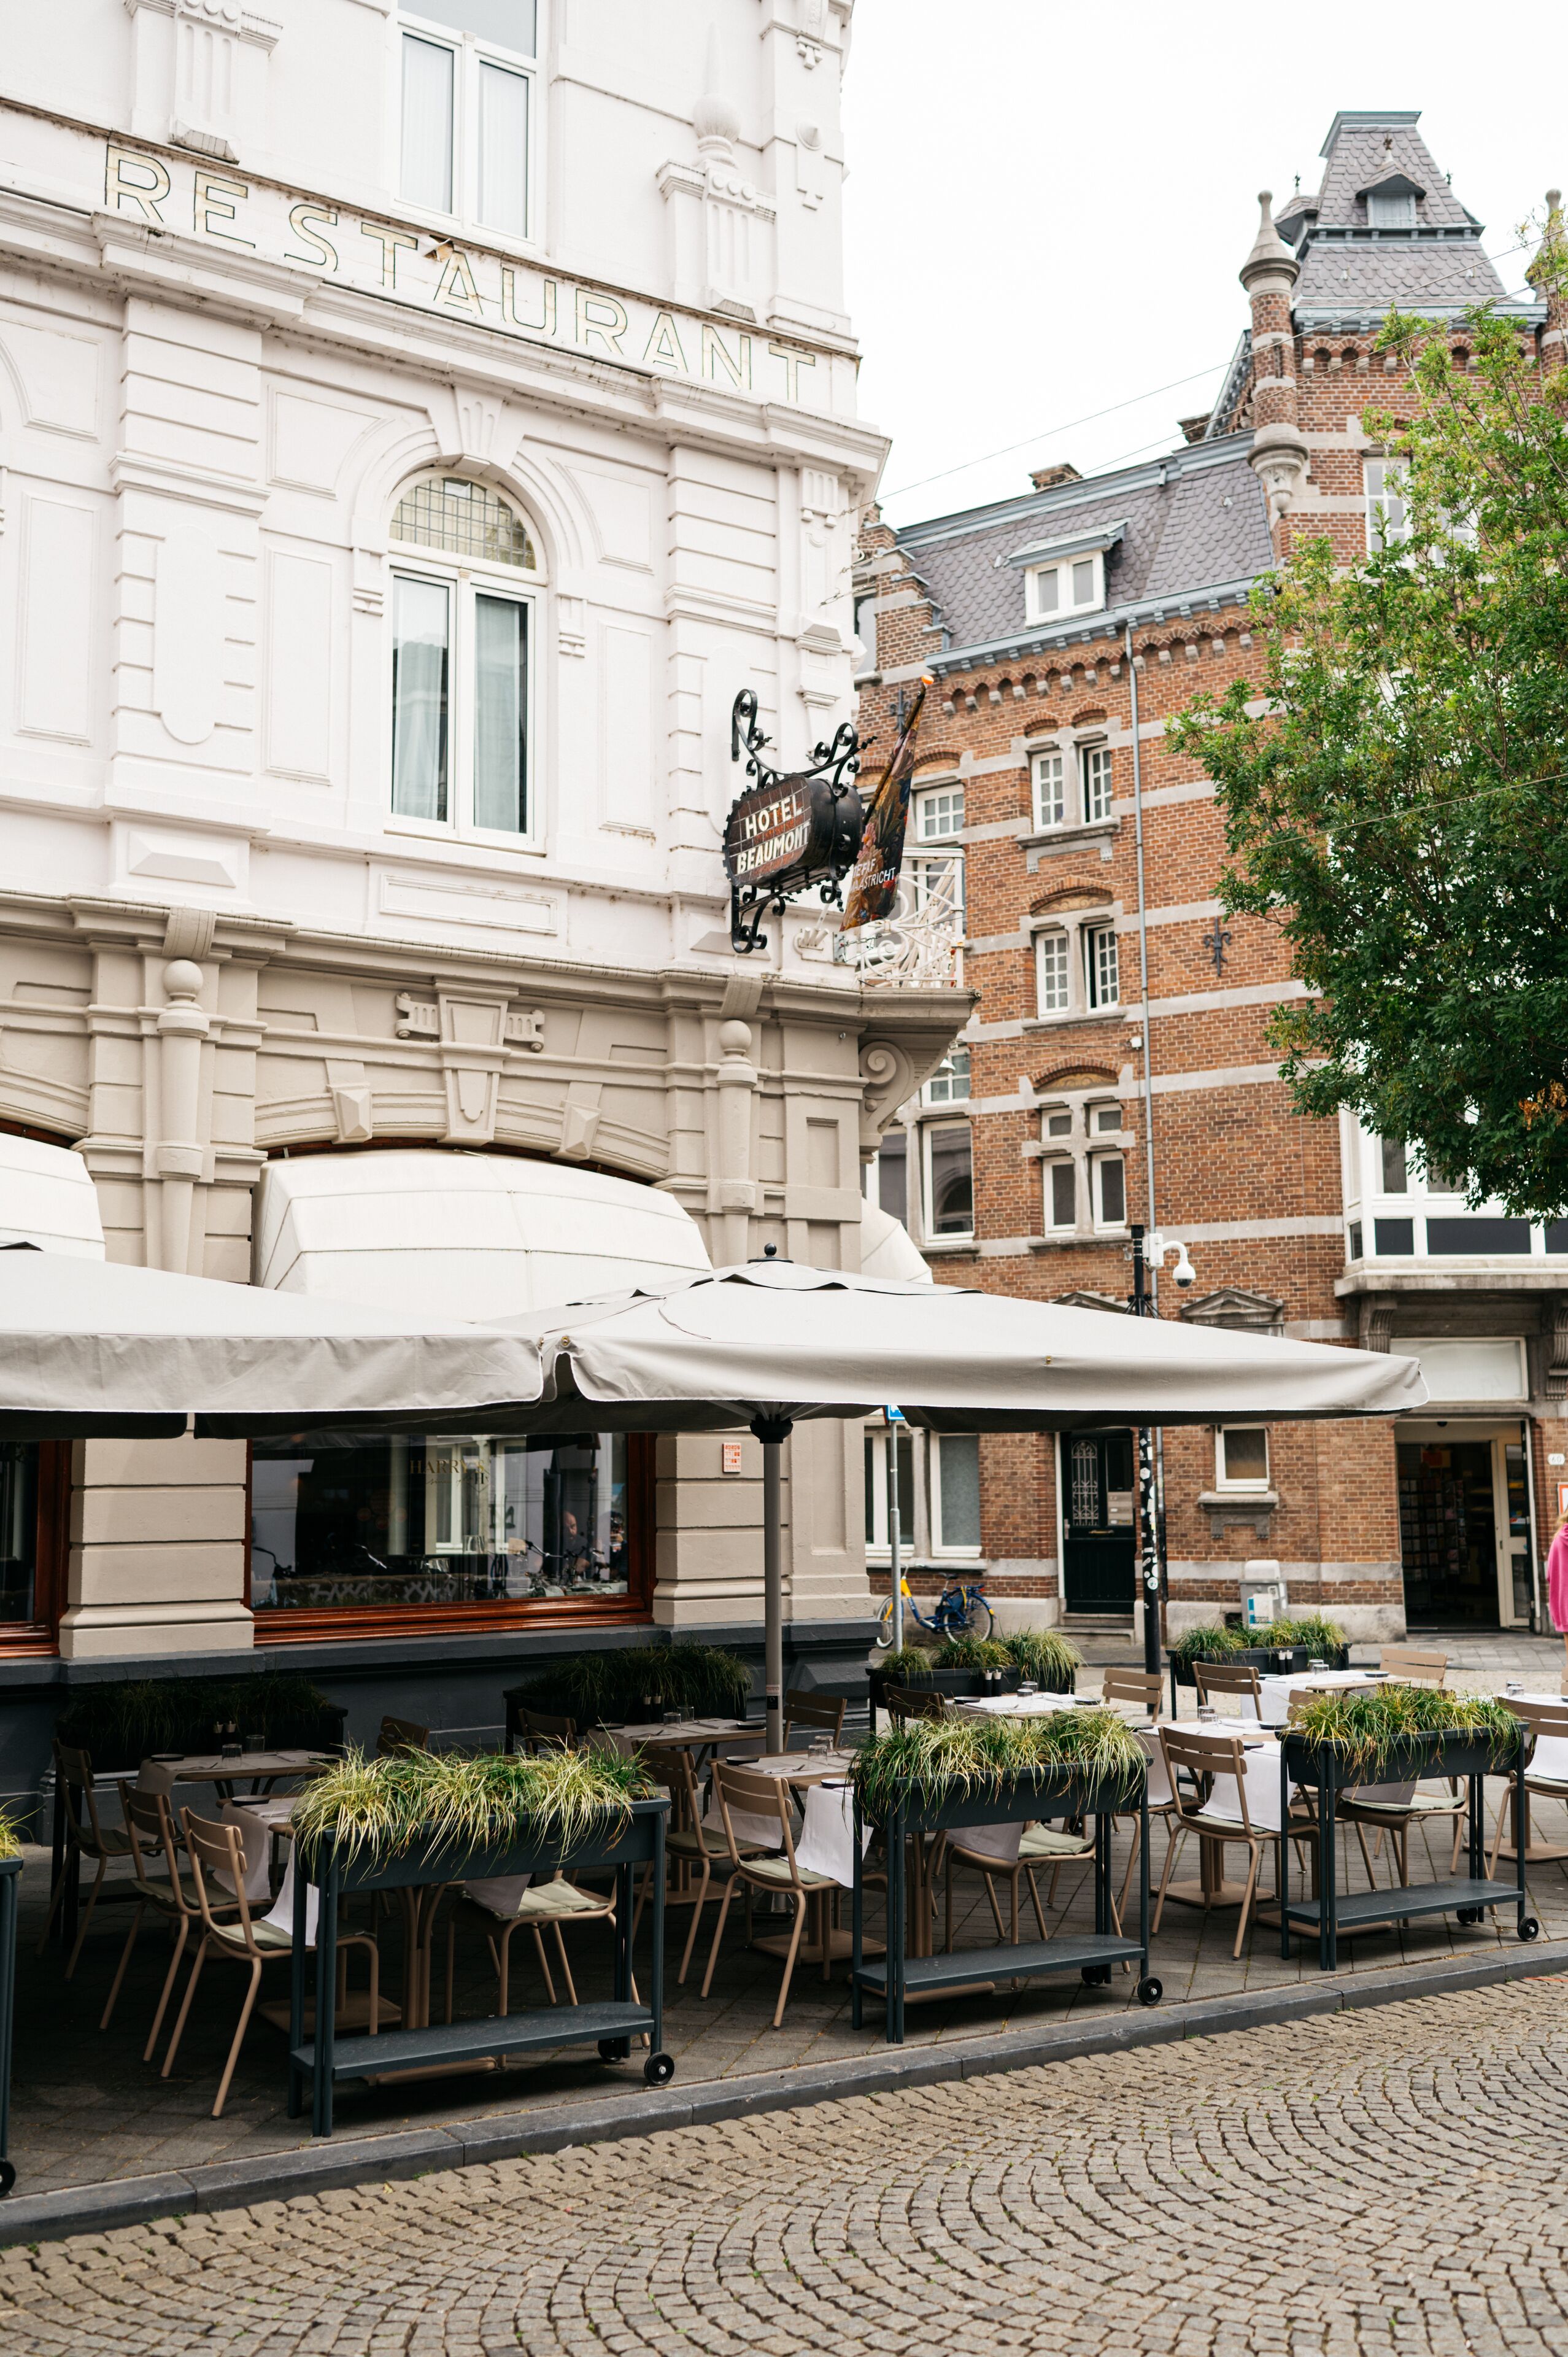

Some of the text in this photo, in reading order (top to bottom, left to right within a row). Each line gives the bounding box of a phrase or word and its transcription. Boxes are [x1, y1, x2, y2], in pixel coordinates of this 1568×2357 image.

[105, 144, 816, 403] RESTAURANT
[745, 794, 803, 840] HOTEL
[736, 821, 811, 875] BEAUMONT
[409, 1458, 485, 1474] HARRYS
